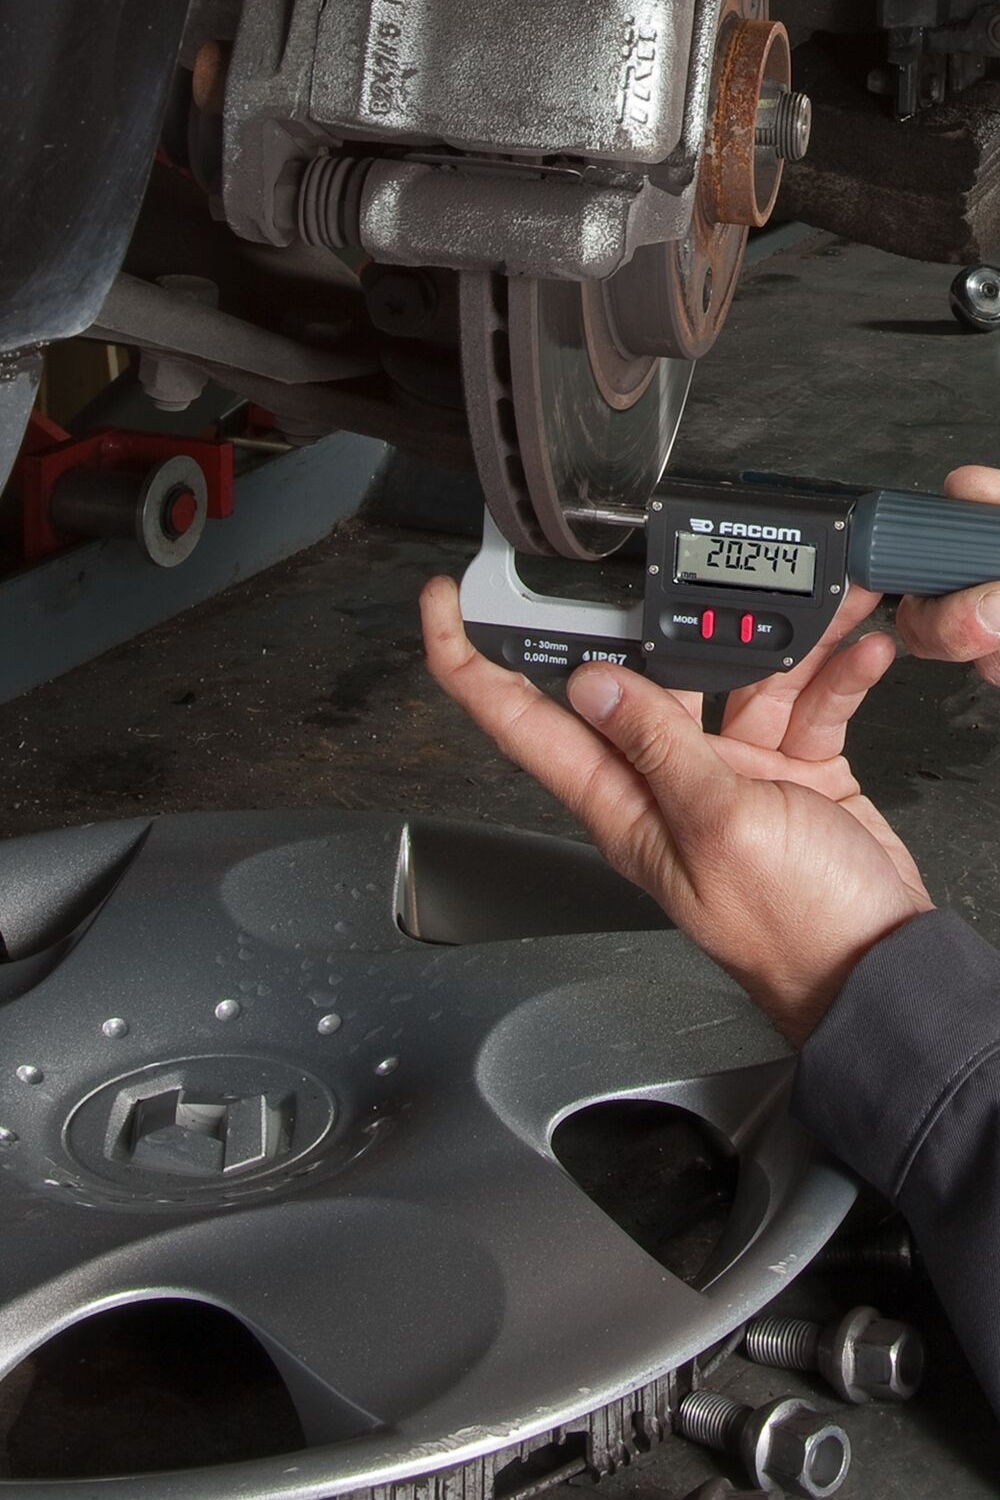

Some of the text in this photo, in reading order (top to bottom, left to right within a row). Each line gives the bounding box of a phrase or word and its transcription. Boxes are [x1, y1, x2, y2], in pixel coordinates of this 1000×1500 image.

[719, 521, 801, 542] FACOM
[707, 538, 799, 574] 20.244
[673, 615, 699, 625] MODE
[756, 624, 773, 633] SET
[538, 640, 569, 652] 30mm
[523, 651, 568, 665] 0,001mm
[592, 651, 628, 666] IP67
